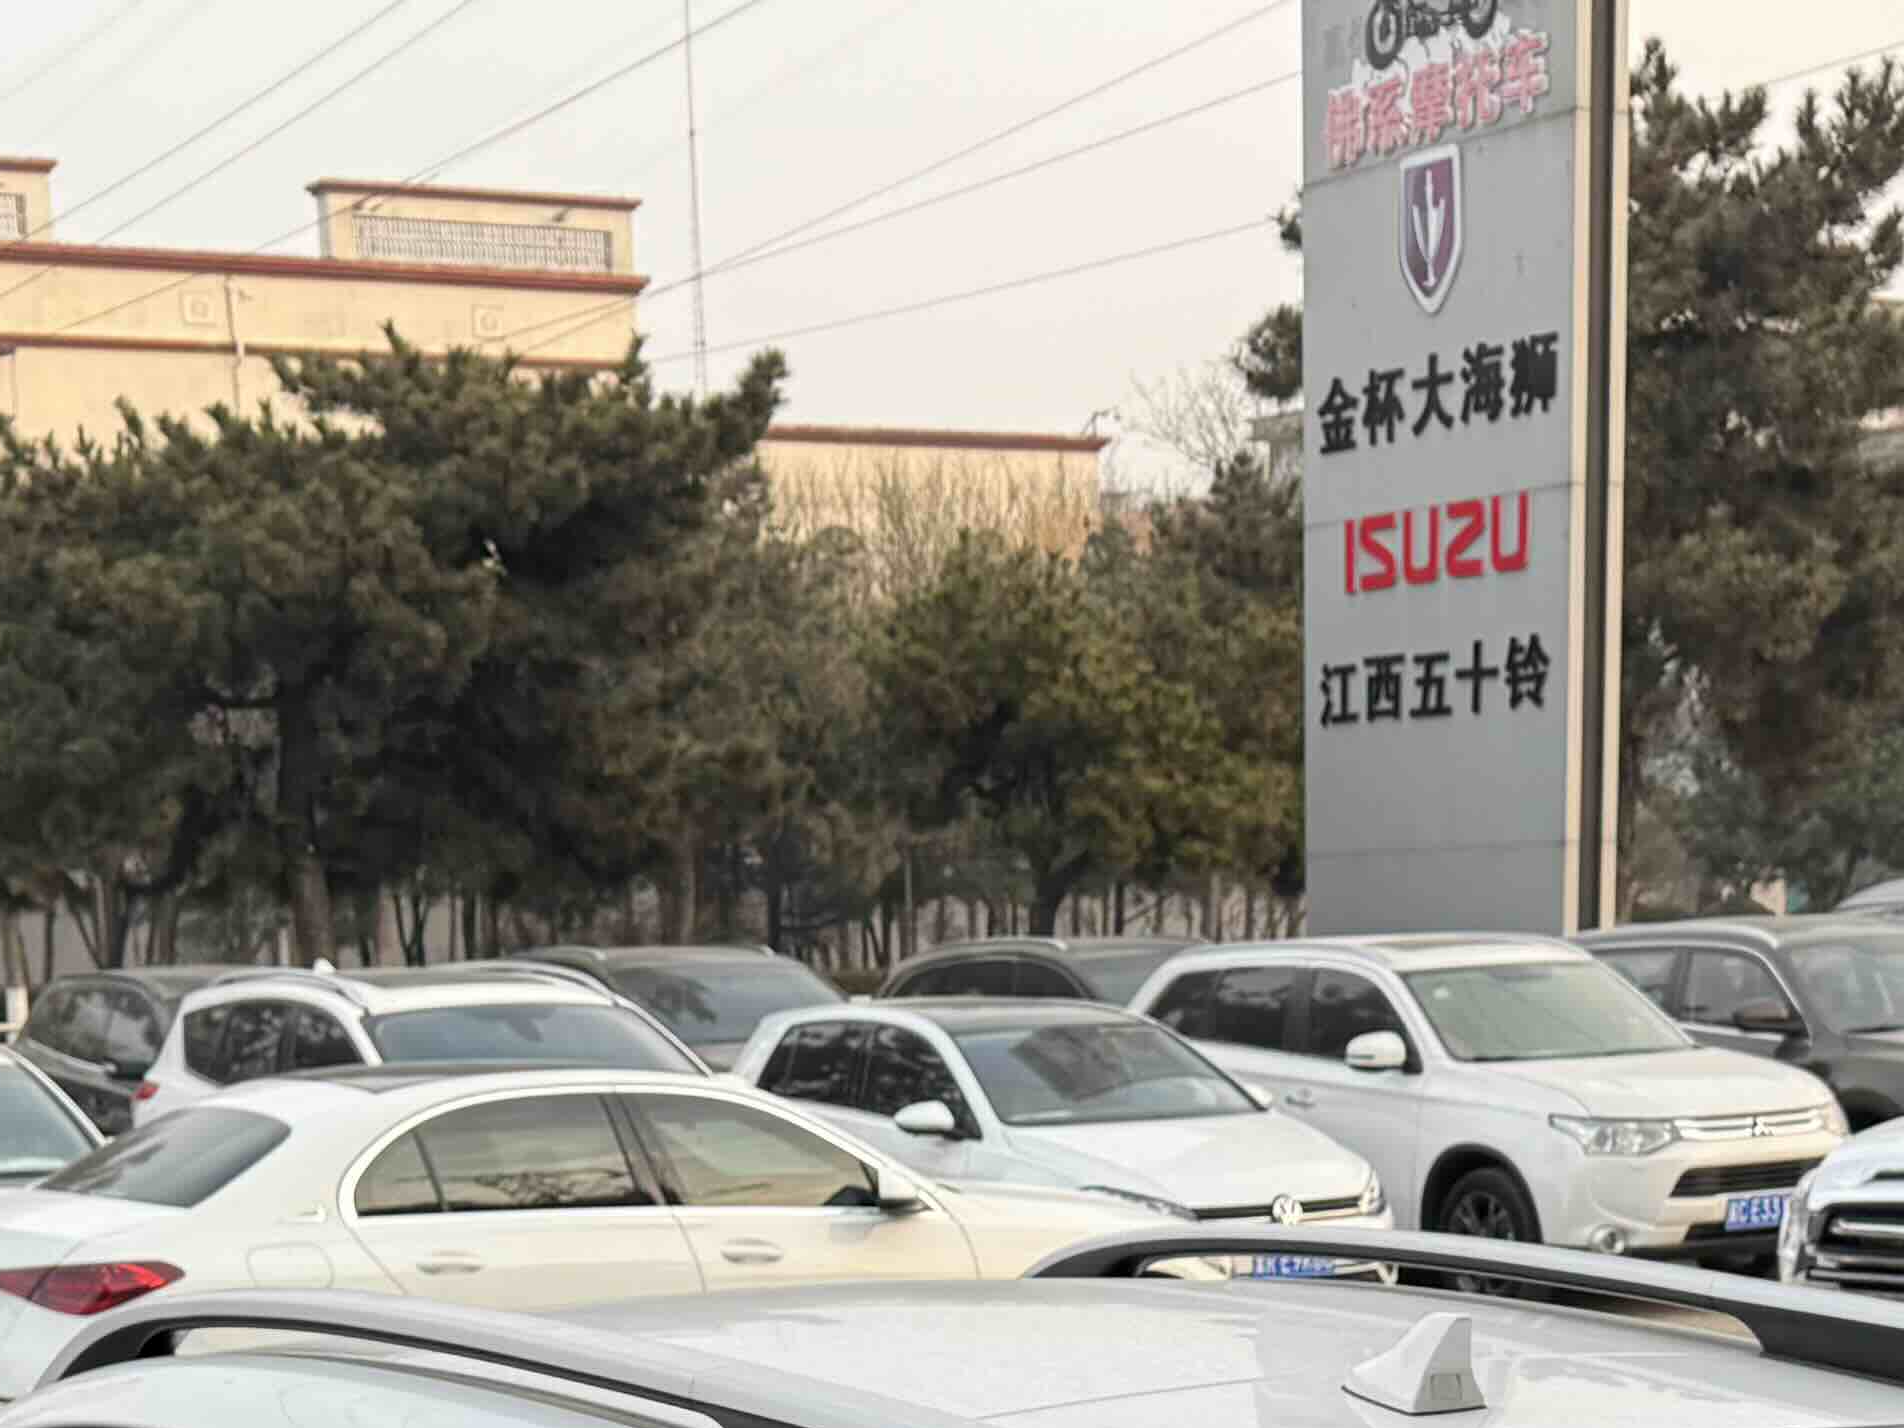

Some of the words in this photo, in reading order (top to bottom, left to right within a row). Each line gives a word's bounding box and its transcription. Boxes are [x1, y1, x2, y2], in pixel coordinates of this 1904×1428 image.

[1317, 332, 1558, 455] 金杯大海狮
[1344, 490, 1529, 594] ISUZU
[1319, 634, 1550, 728] 江西五十铃
